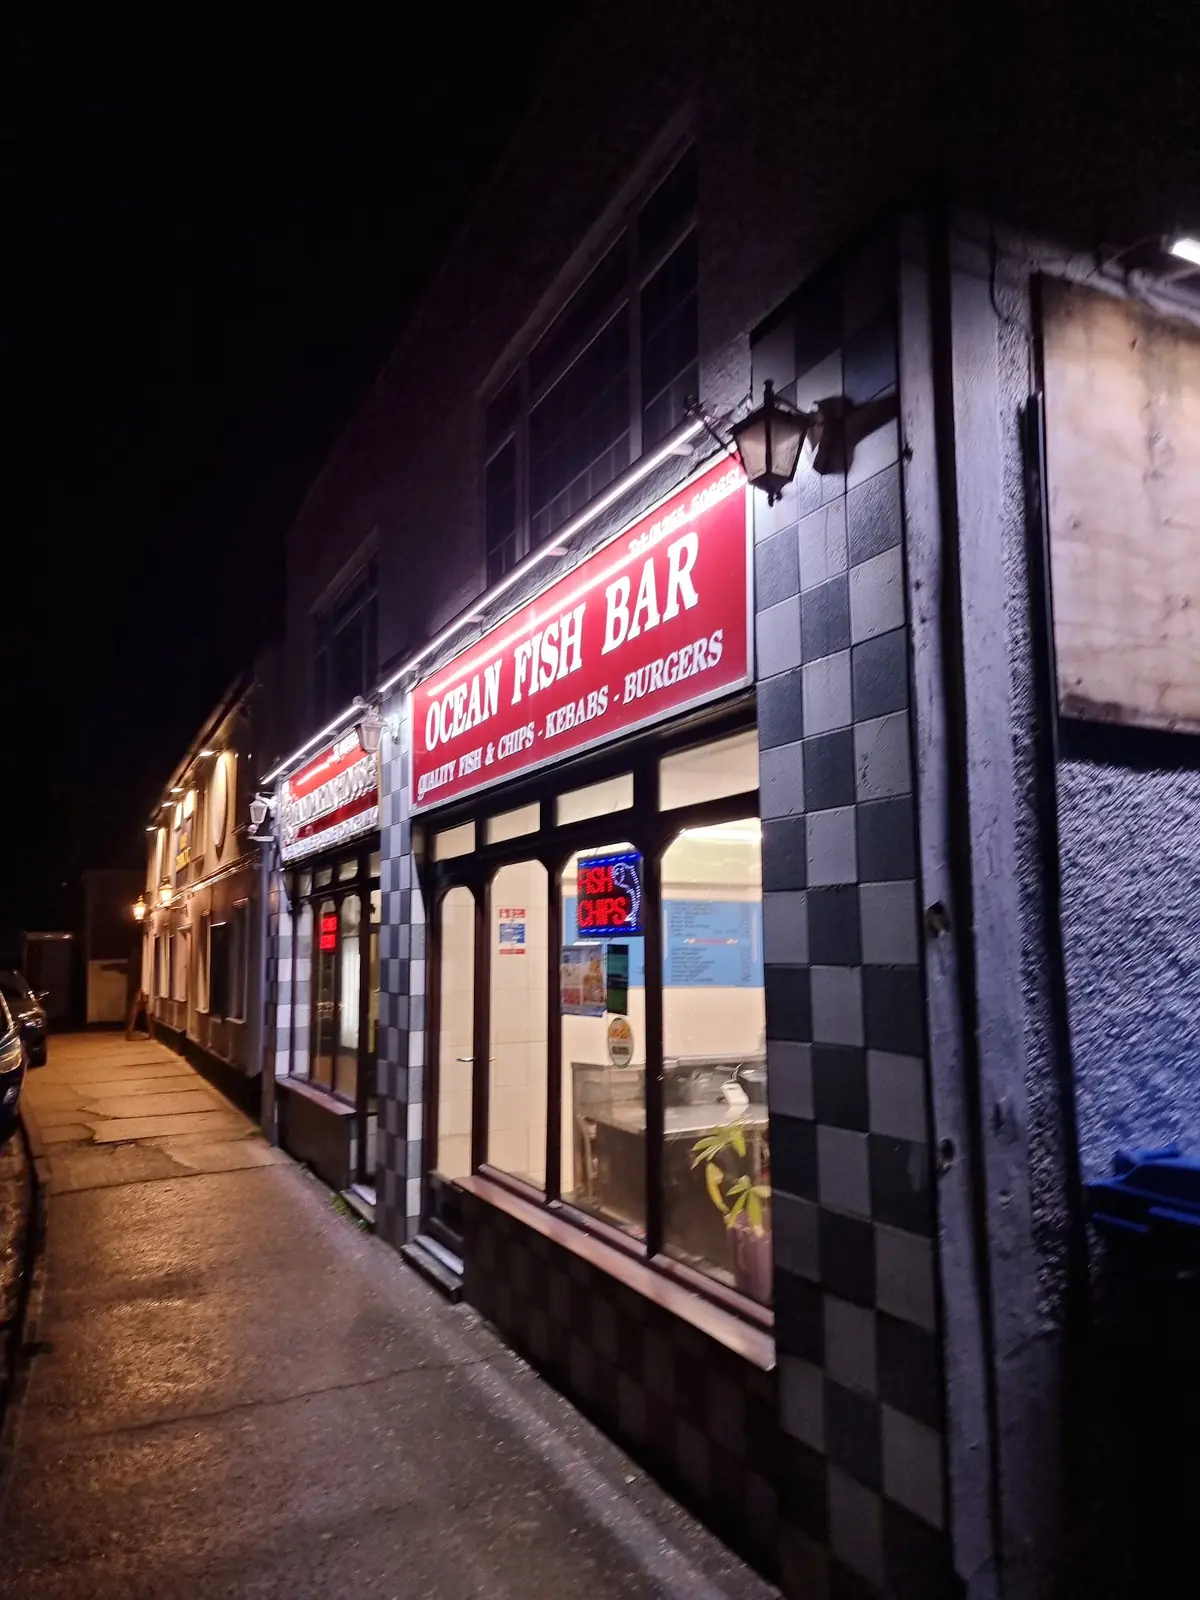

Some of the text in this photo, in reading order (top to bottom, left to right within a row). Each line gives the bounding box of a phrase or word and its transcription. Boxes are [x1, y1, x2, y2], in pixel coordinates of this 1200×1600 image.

[417, 759, 457, 801] QUALITY
[458, 747, 483, 778] FISH
[485, 742, 495, 766] &
[498, 723, 535, 759] CHIPS
[544, 686, 609, 740] KEBABS
[622, 628, 724, 706] BURGERS
[425, 531, 699, 752] OCEAN FISH BAR
[577, 897, 627, 927] CHIPS
